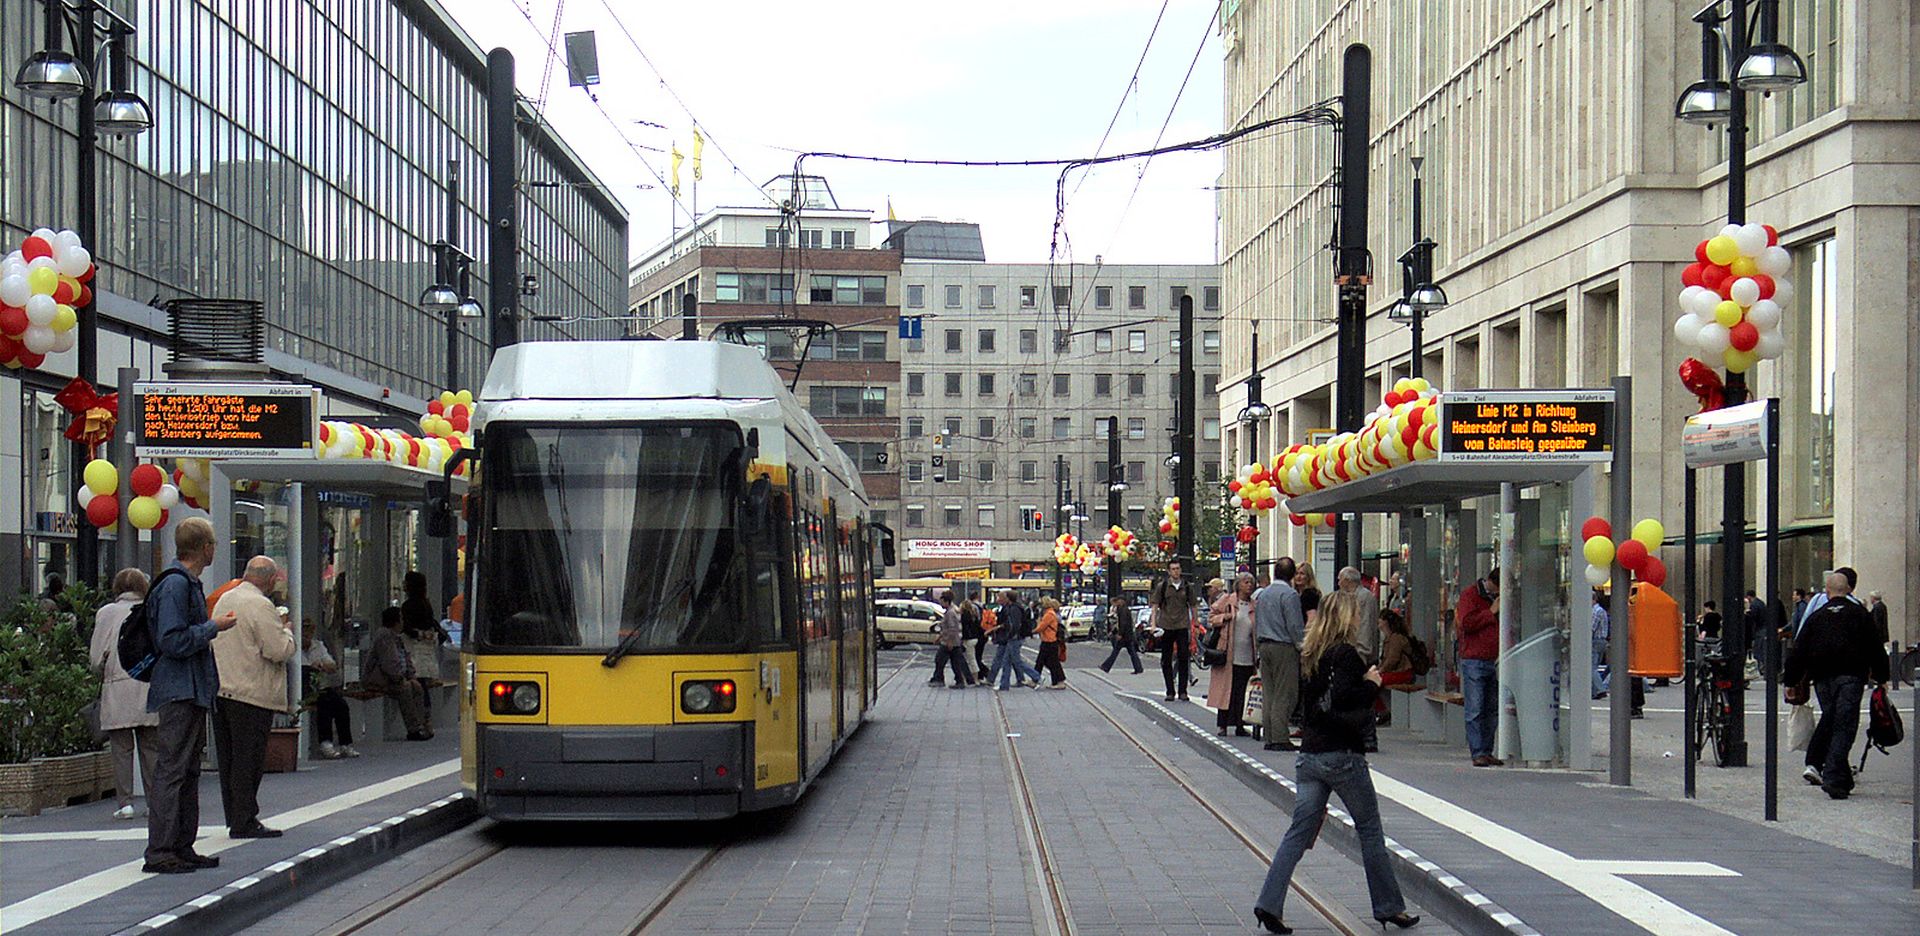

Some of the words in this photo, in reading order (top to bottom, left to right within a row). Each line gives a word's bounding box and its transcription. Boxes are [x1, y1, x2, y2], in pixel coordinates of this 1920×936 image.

[145, 404, 156, 412] ab
[230, 404, 245, 413] hat
[265, 404, 278, 413] M2
[1477, 404, 1499, 417] Linie
[1503, 404, 1519, 417] M2
[1523, 404, 1532, 417] in
[1536, 403, 1577, 420] Richtung
[1452, 420, 1508, 434] Heinersdorf
[1511, 420, 1529, 434] und
[1532, 420, 1548, 434] Am
[1551, 420, 1597, 436] Steinberg
[934, 435, 942, 445] 2
[1464, 439, 1484, 450] vom
[1488, 437, 1535, 452] Bahnsteig
[1538, 436, 1588, 452] gegenüber
